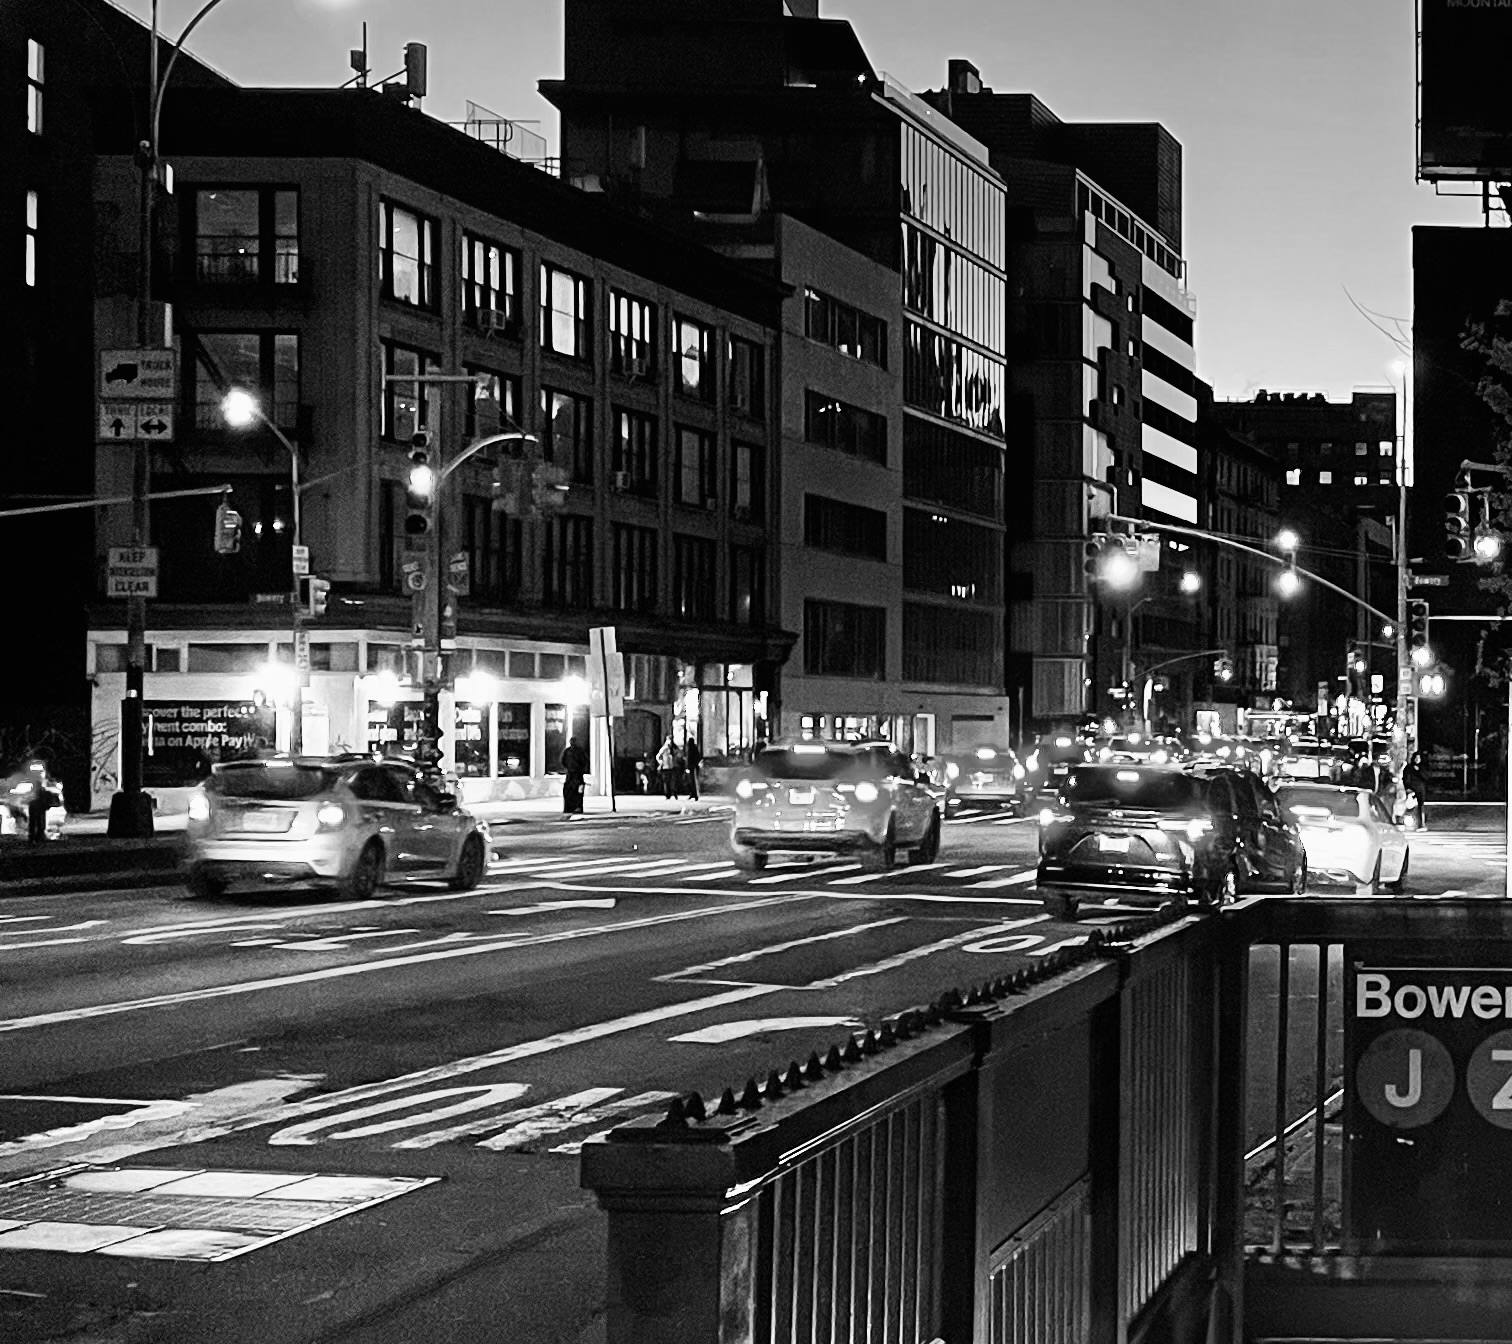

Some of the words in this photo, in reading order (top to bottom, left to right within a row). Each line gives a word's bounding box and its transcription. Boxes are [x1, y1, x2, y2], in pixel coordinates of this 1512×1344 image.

[180, 705, 201, 718] the
[181, 719, 228, 733] combo:
[185, 734, 220, 749] Apple
[1384, 1049, 1421, 1108] J
